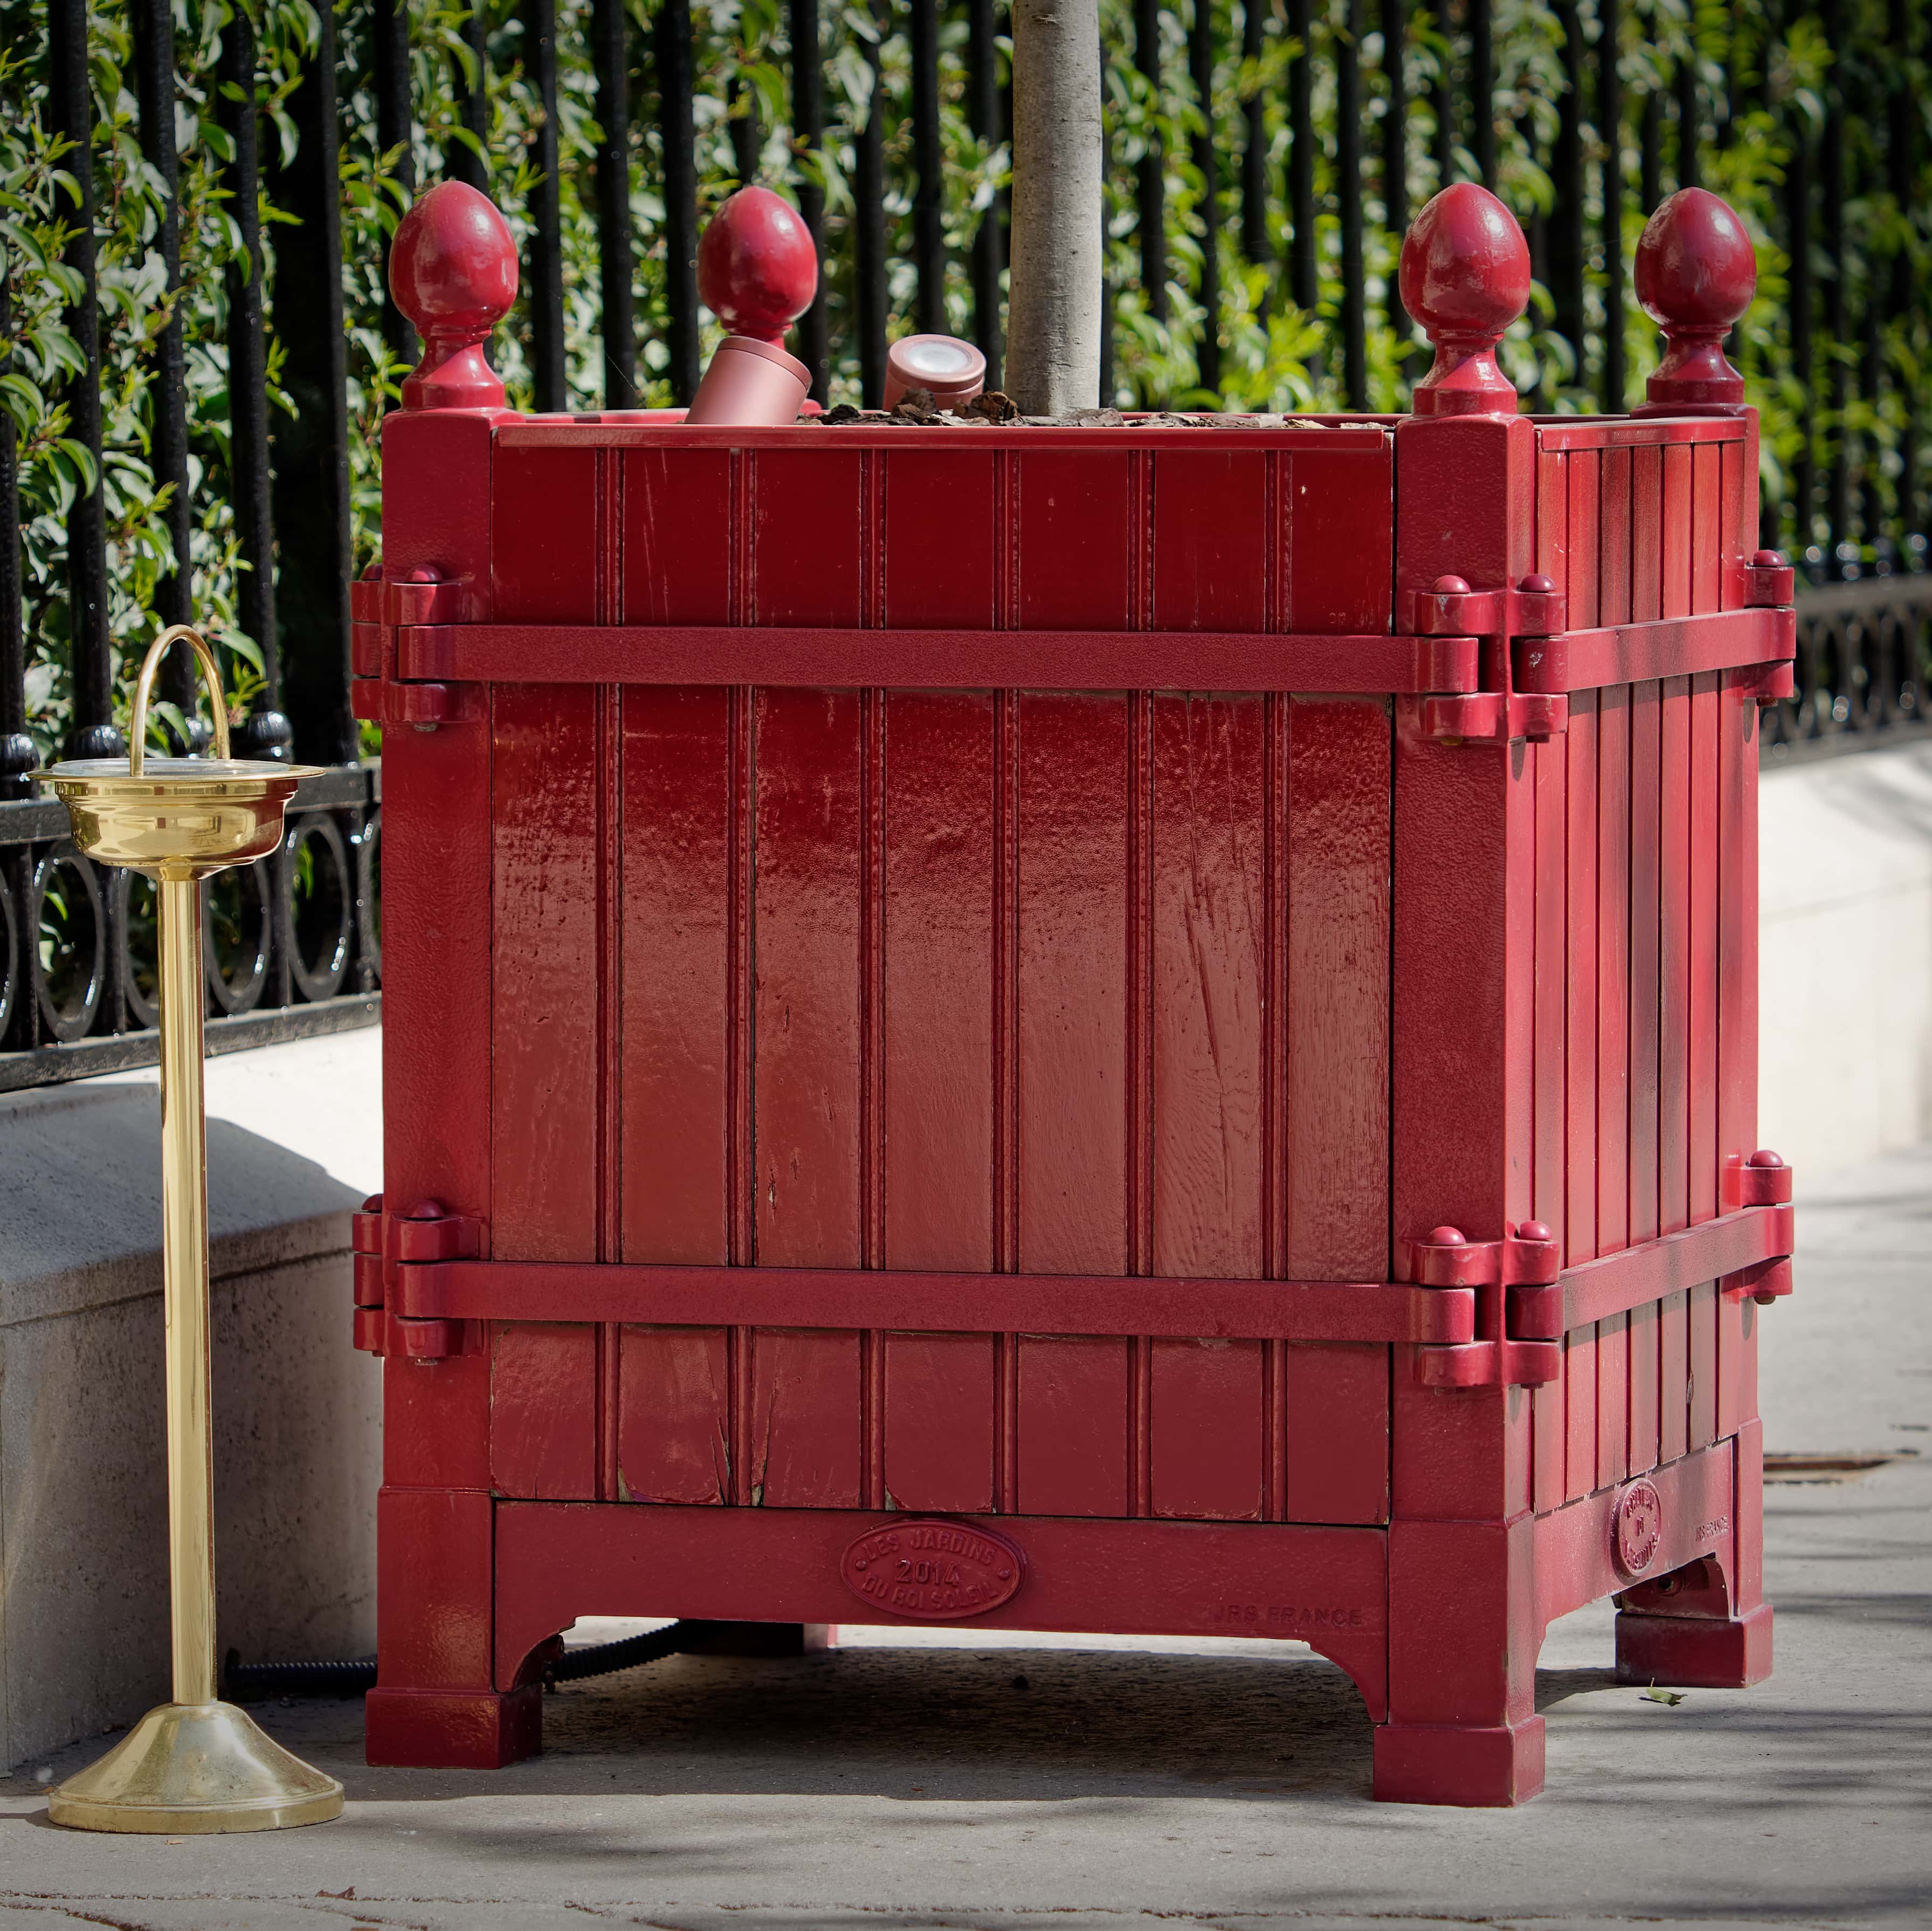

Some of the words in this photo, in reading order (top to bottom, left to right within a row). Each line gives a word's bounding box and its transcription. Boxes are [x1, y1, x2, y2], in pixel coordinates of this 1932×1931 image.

[862, 1533, 899, 1562] LES
[910, 1529, 997, 1566] JARDINS
[895, 1559, 961, 1587] 2014
[862, 1574, 889, 1598] DU
[892, 1587, 923, 1609] ROI
[931, 1582, 999, 1609] SOLEIL
[1267, 1606, 1364, 1627] FRANCE
